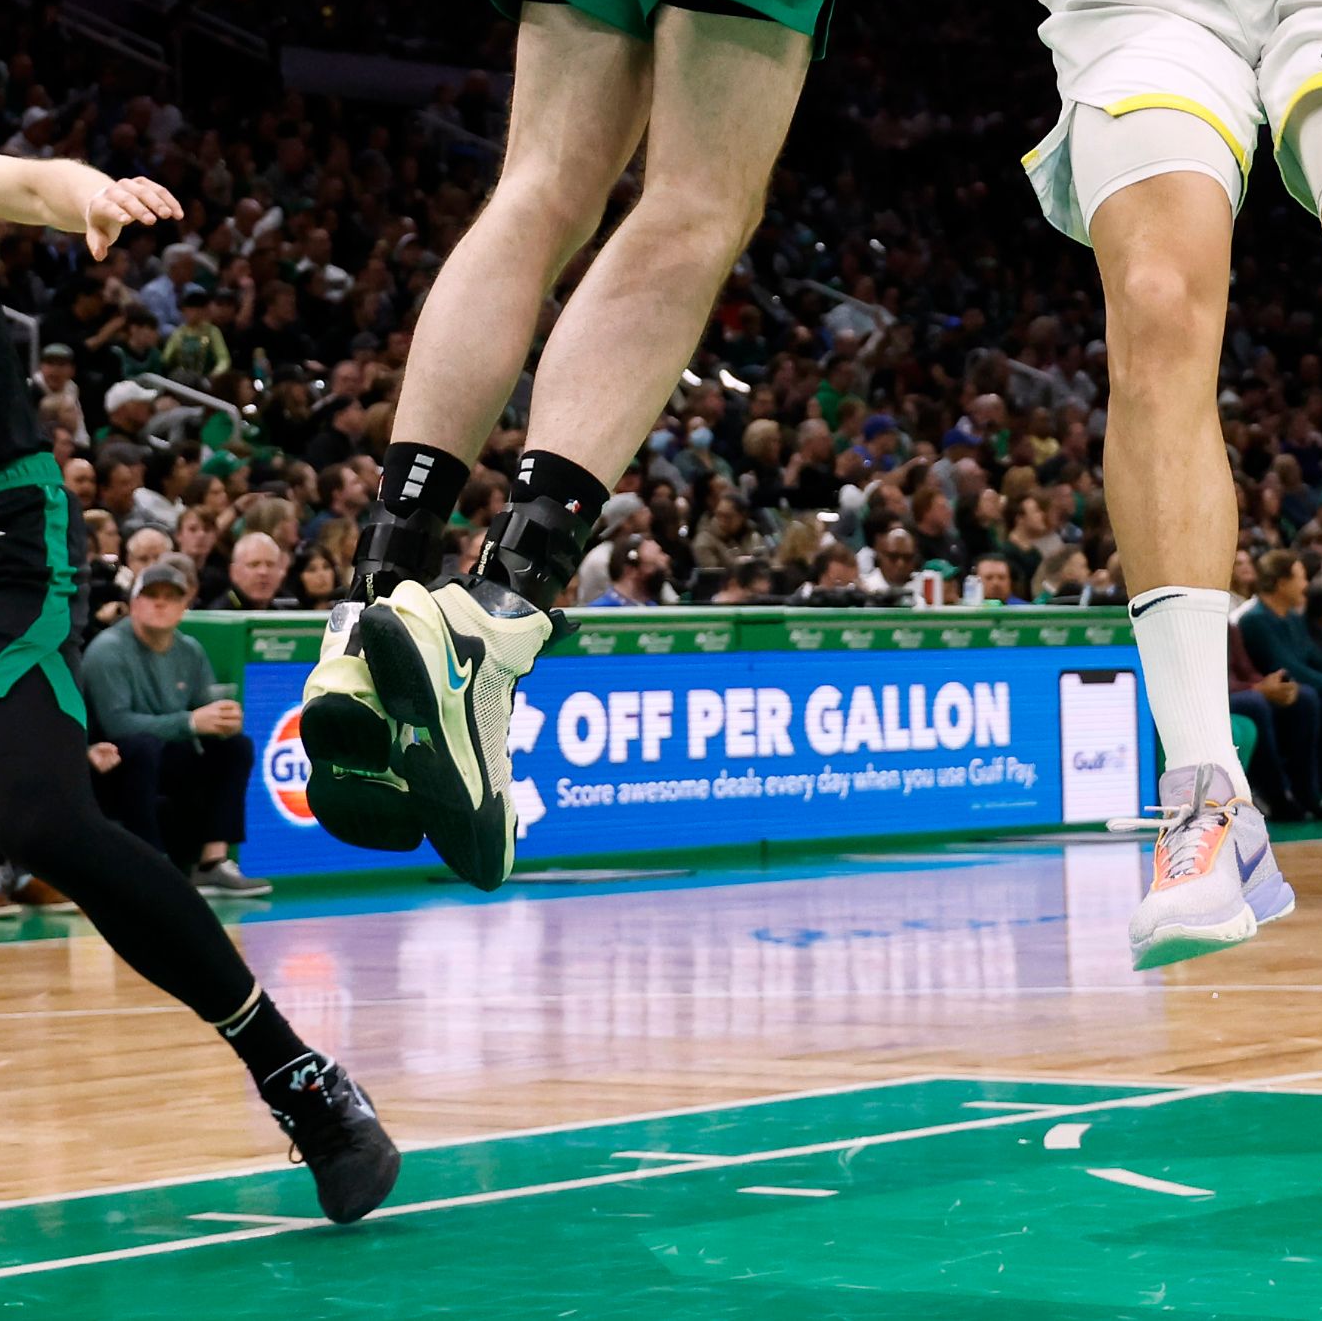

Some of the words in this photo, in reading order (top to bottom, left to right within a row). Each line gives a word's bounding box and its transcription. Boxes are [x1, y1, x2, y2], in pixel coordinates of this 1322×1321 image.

[557, 690, 674, 767] OFF
[686, 686, 795, 760] PER
[804, 681, 1011, 756] GALLON
[556, 777, 616, 809] Score
[616, 778, 711, 805] awesome
[711, 767, 763, 800] deals
[764, 774, 816, 802] every
[816, 764, 851, 800] day
[852, 762, 901, 792] when
[901, 769, 936, 796] you
[936, 766, 967, 788] use
[968, 755, 1004, 787] Gulf
